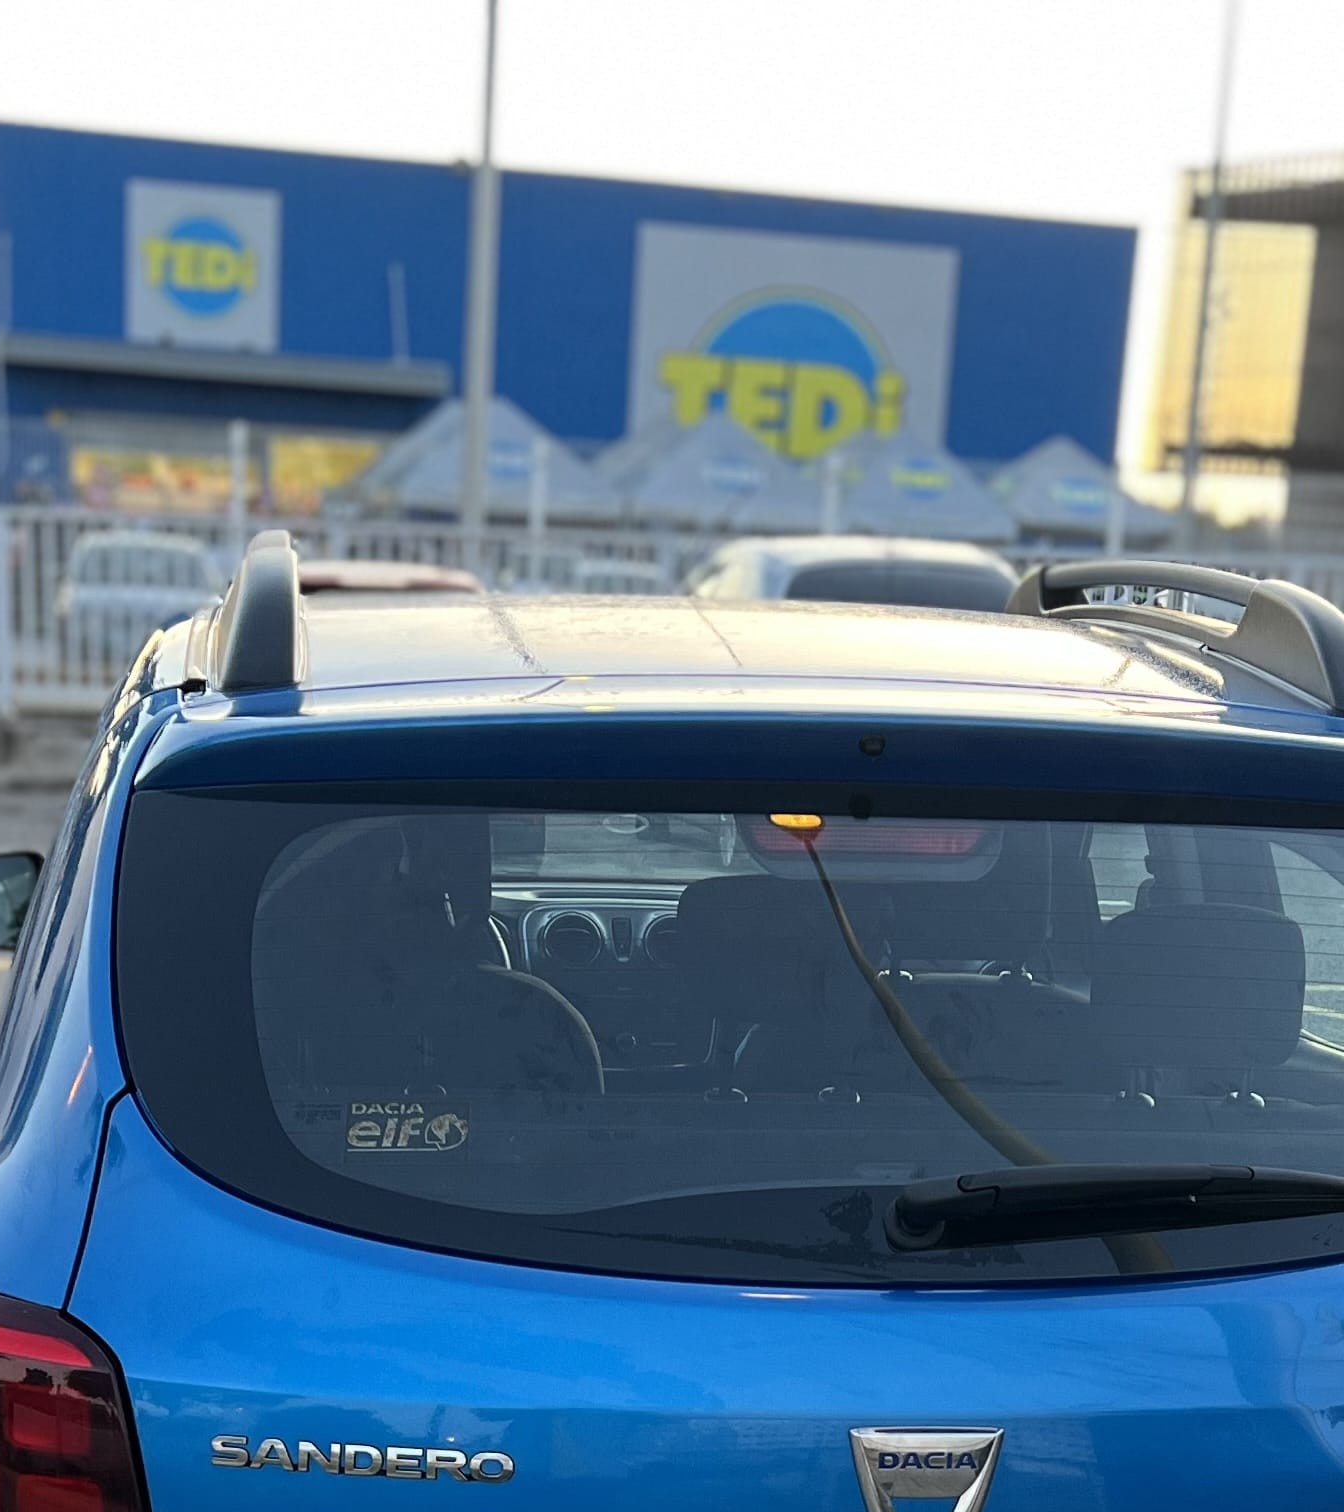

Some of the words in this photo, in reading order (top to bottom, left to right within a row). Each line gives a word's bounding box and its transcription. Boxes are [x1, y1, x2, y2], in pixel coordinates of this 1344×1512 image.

[659, 353, 905, 459] TEDi
[351, 1103, 425, 1115] DACIA
[209, 1434, 516, 1483] SANDERO
[877, 1451, 978, 1470] DACIA
